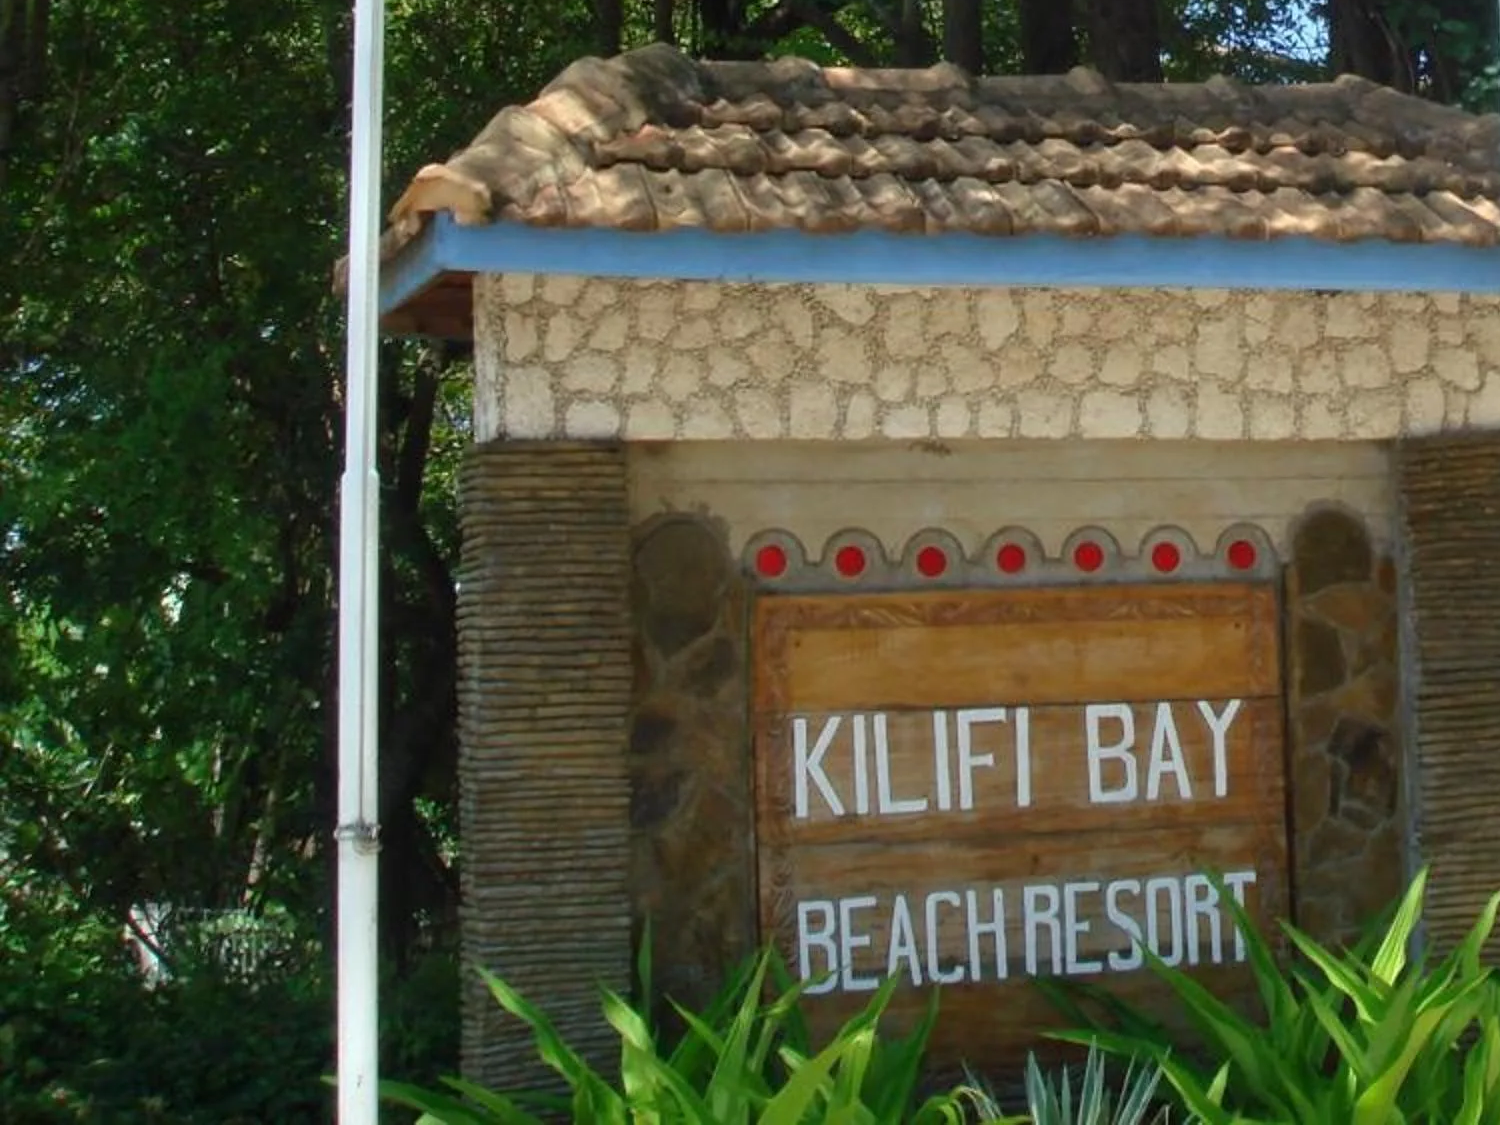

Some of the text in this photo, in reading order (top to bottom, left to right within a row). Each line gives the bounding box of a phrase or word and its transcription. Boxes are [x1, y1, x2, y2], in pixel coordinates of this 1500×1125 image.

[792, 699, 1242, 818] KILIFI BAY
[796, 871, 1257, 995] BEACH RESORT
